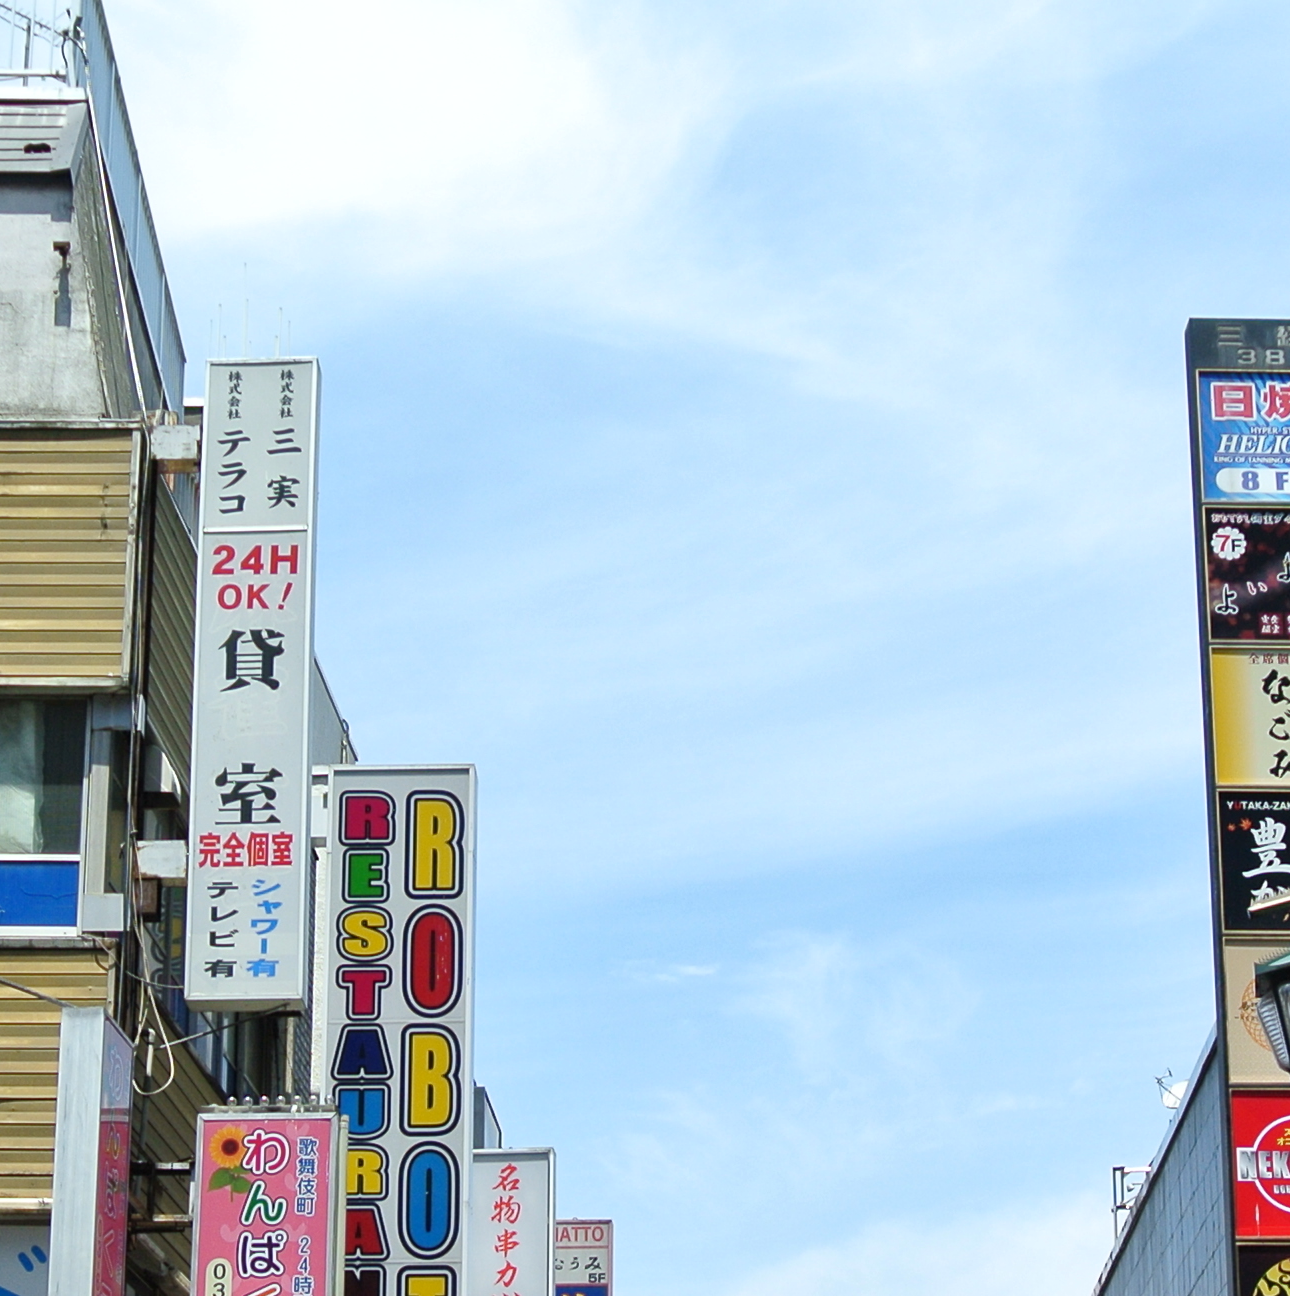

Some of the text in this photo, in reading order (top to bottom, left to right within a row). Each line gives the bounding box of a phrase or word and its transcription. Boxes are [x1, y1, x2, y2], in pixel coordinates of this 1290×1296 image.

[278, 369, 294, 420] 株式会社
[215, 370, 252, 515] 株式会社 テラコ
[1250, 427, 1278, 435] HYPER
[1249, 456, 1283, 464] TANNING
[211, 545, 300, 576] 24H
[1214, 534, 1243, 553] 7F
[216, 581, 293, 611] OK!
[198, 831, 294, 869] 完全個室
[203, 879, 240, 980] テレビ有
[246, 878, 283, 980] シャワー有
[294, 1137, 318, 1216] 歌舞伎町
[587, 1272, 607, 1284] 5F
